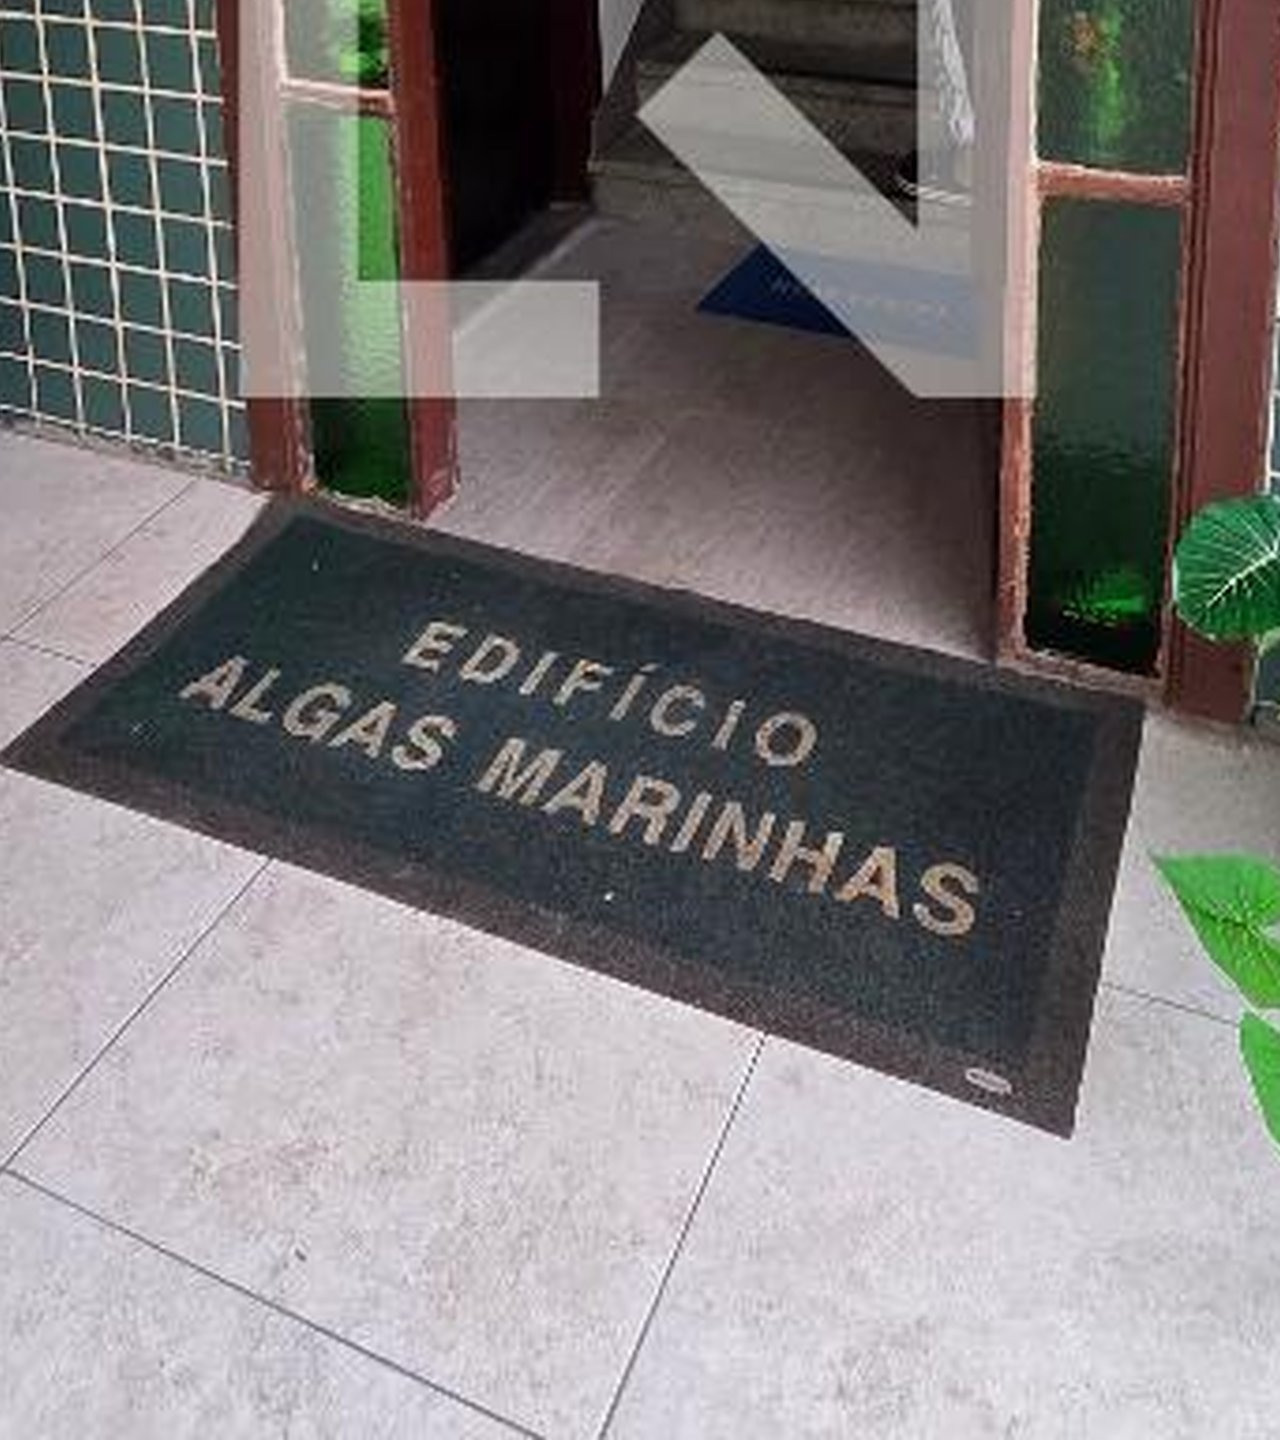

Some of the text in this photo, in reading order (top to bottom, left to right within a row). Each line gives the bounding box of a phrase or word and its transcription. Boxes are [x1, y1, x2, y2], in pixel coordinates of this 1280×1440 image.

[179, 653, 981, 938] ALGAS MARINHAS
[401, 620, 819, 768] EDIFÍCIO
